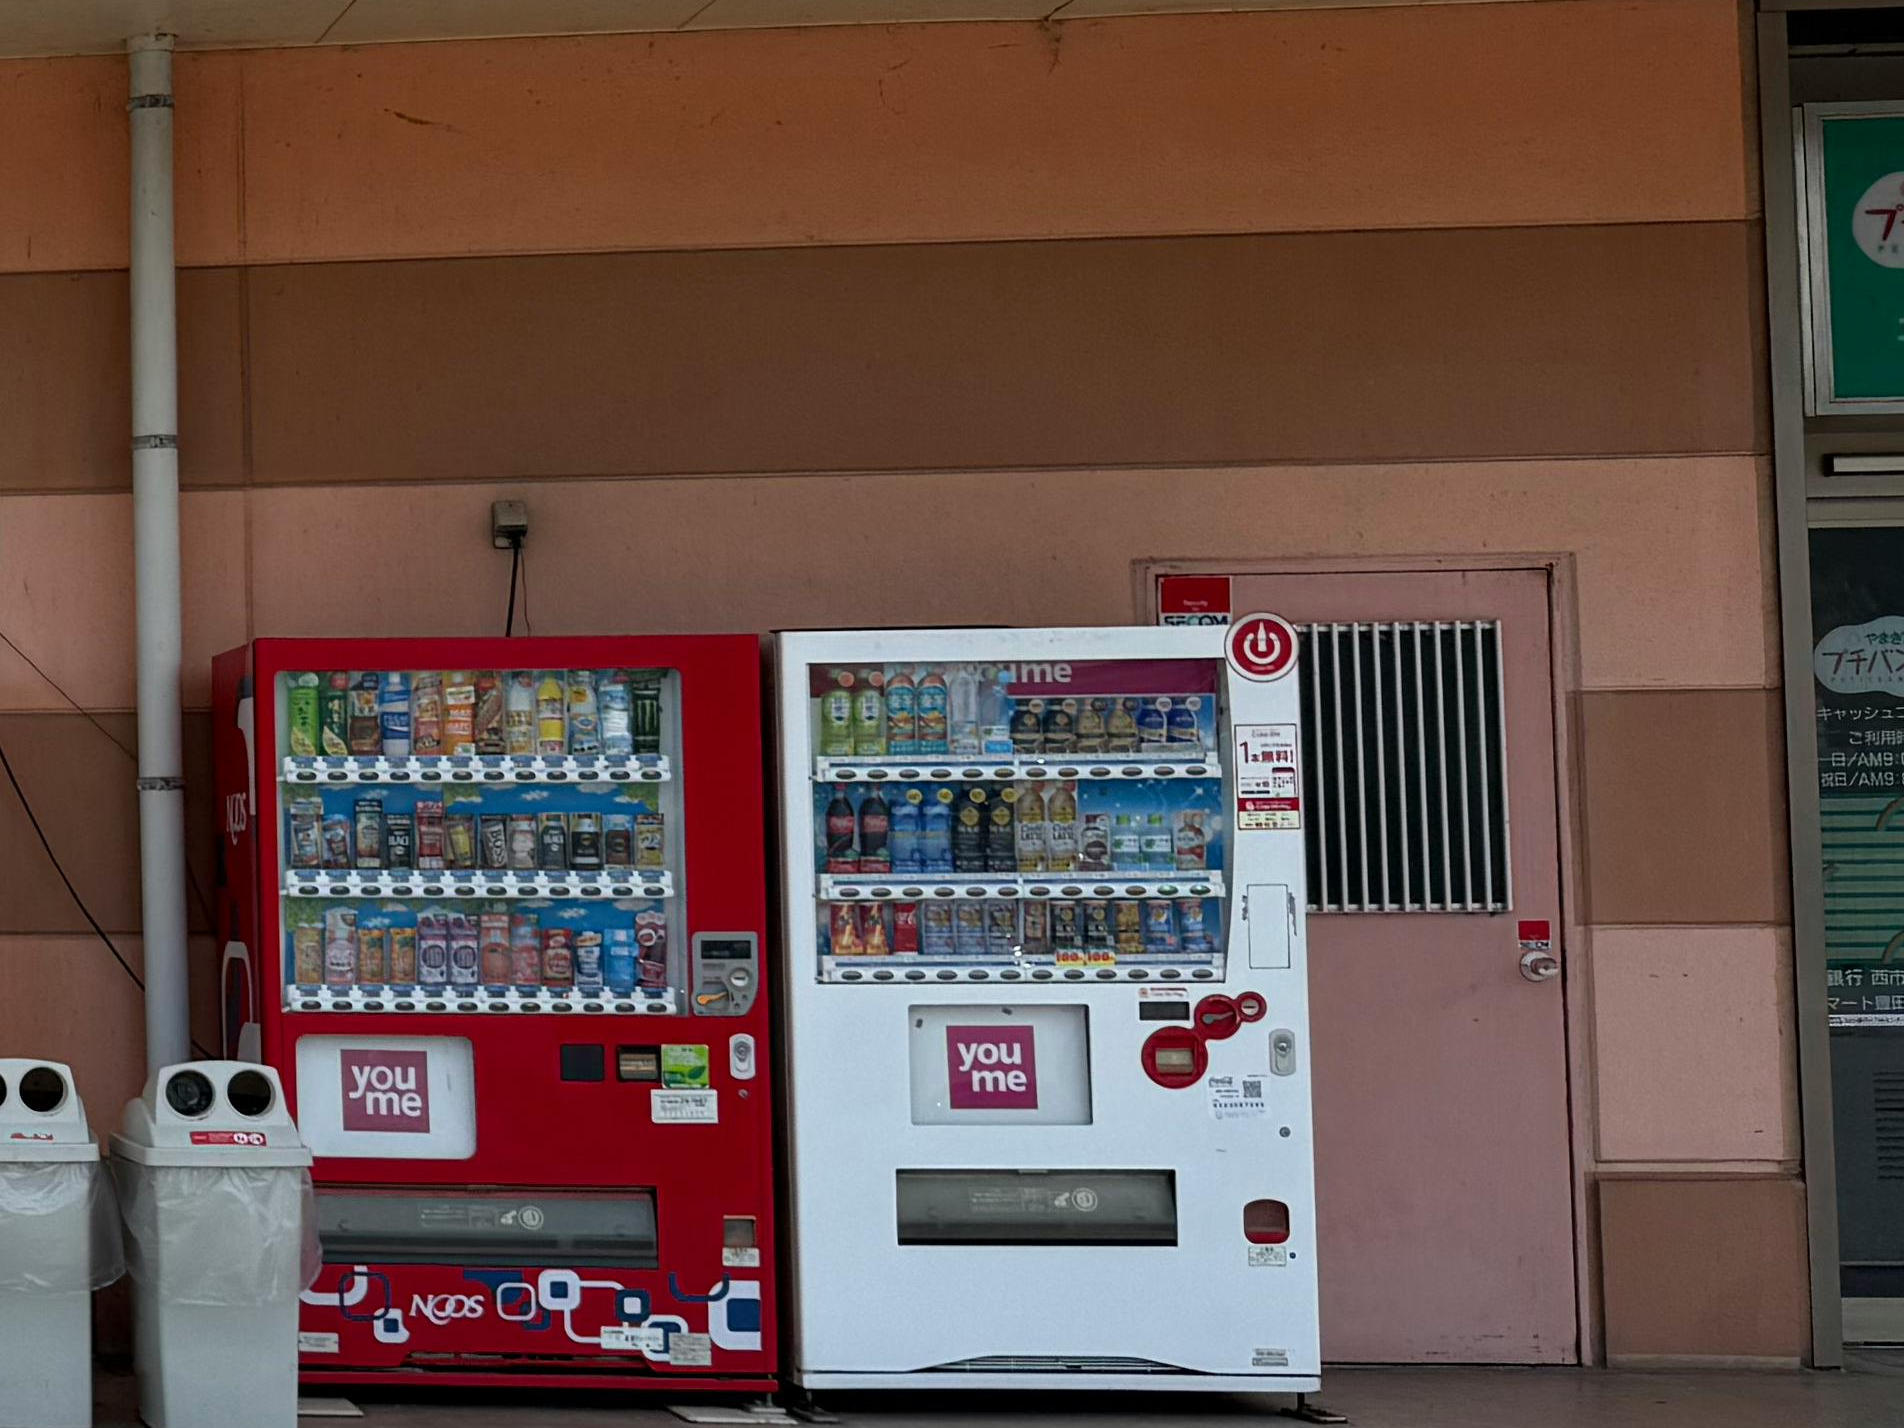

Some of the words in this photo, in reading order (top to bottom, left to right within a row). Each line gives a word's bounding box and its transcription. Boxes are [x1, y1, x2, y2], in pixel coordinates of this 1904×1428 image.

[956, 1040, 1022, 1068] you
[348, 1064, 416, 1099] you
[971, 1068, 1027, 1093] me
[365, 1088, 423, 1117] me
